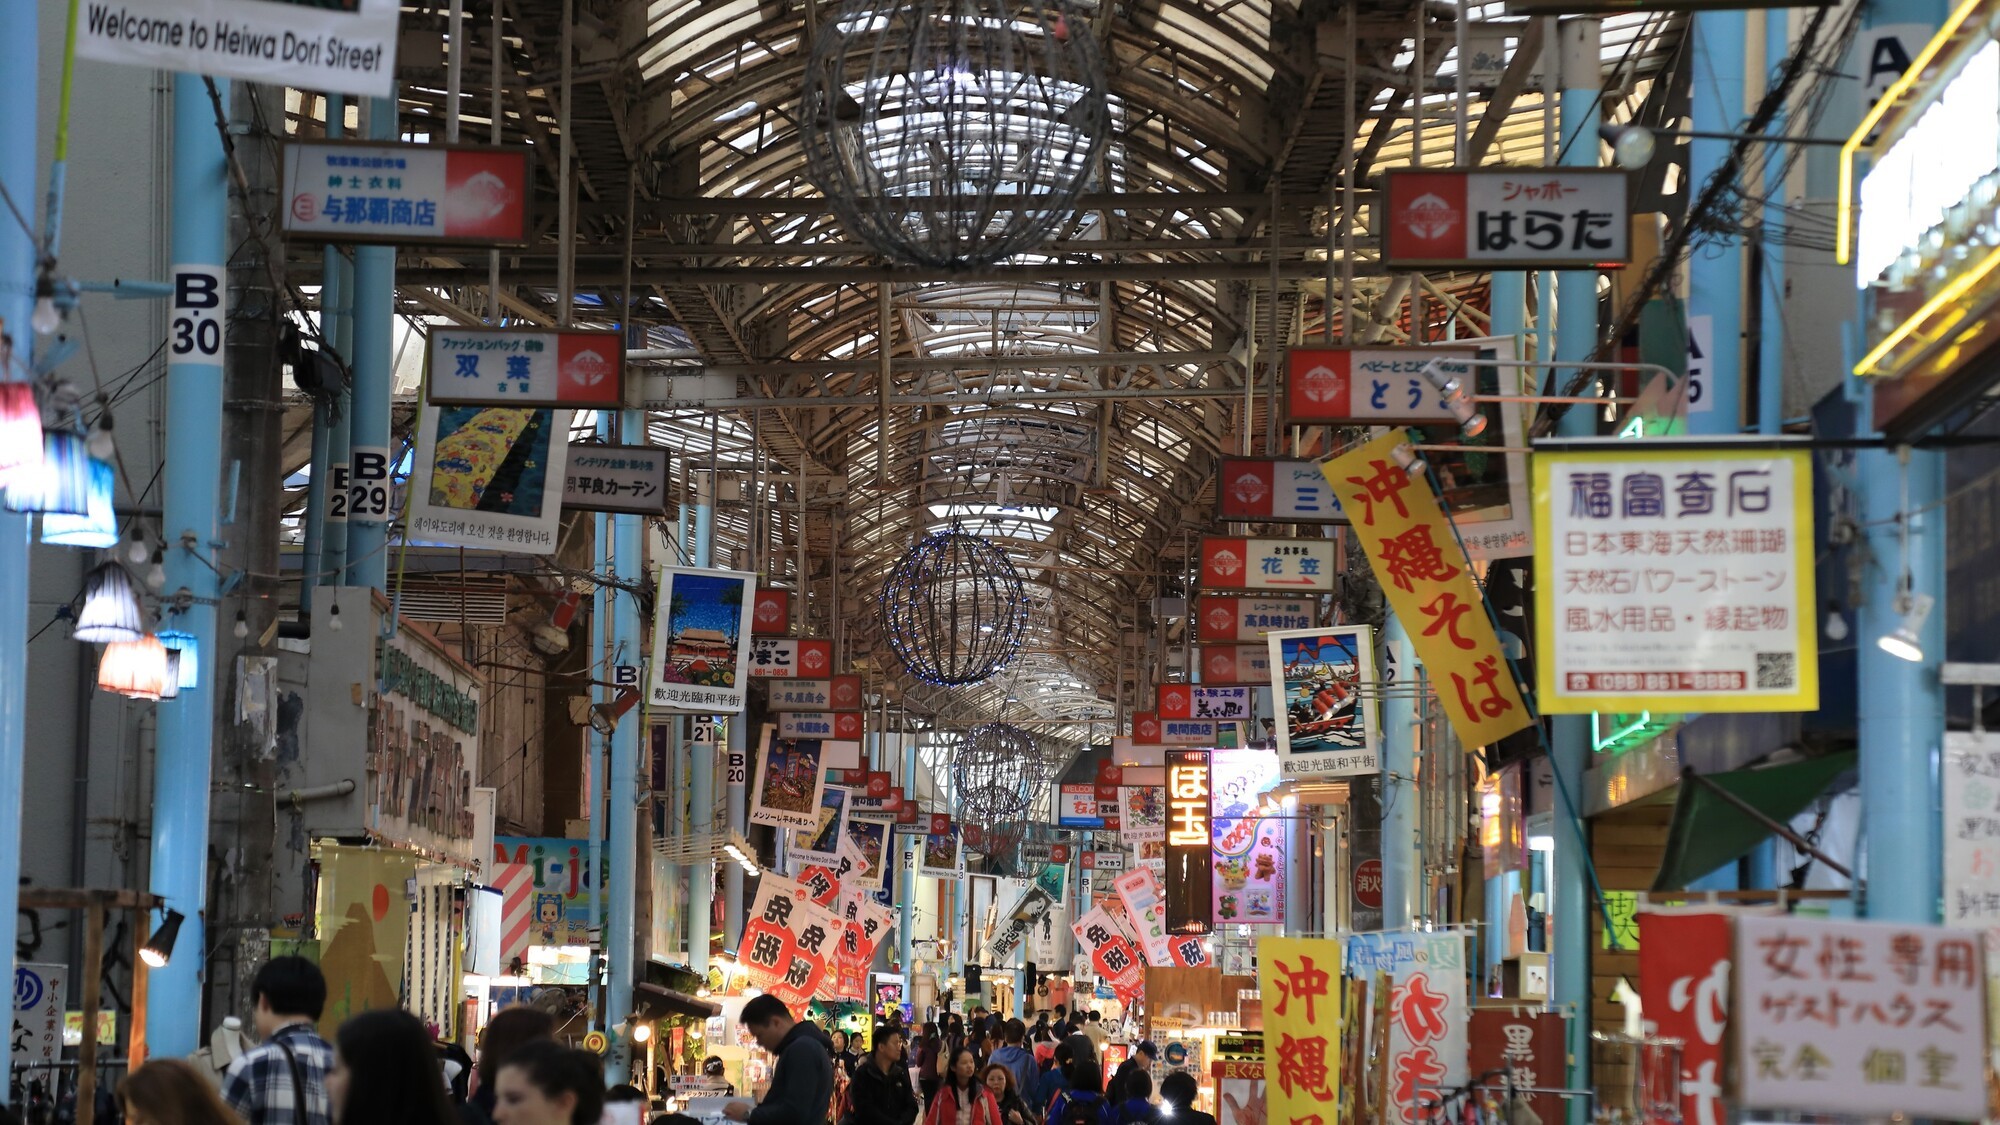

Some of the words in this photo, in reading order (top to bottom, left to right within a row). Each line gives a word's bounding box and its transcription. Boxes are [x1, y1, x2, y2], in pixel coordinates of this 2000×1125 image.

[89, 4, 182, 45] Welcome
[190, 20, 207, 50] to
[214, 23, 276, 59] Heiwa
[282, 30, 322, 65] Dori
[325, 36, 382, 71] Street
[328, 175, 402, 190] 紳士衣料
[322, 194, 436, 227] 与那覇商店
[1477, 209, 1613, 251] はらだ
[172, 317, 220, 356] 30
[1371, 379, 1449, 410] とう
[578, 477, 657, 497] 平良カーテン
[1293, 470, 1326, 480] ジーン
[351, 486, 386, 515] 29
[414, 517, 465, 535] 헤이와도리에
[467, 524, 485, 538] 오신
[488, 526, 504, 540] 것을
[1565, 528, 1787, 556] 日本東海天然珊瑚
[1261, 557, 1320, 575] 花笠
[1347, 459, 1513, 723] 沖縄そば
[1565, 568, 1787, 594] 天然石パワーストーン
[1565, 605, 1789, 633] 風水用品・縁起物
[694, 727, 711, 742] 21
[728, 770, 744, 782] 20
[1100, 805, 1119, 813] 宮城
[1357, 873, 1382, 893] 消火
[1086, 923, 1130, 973] 免税
[1760, 988, 1965, 1033] ゲストハウス
[1273, 955, 1334, 1125] 沖縄
